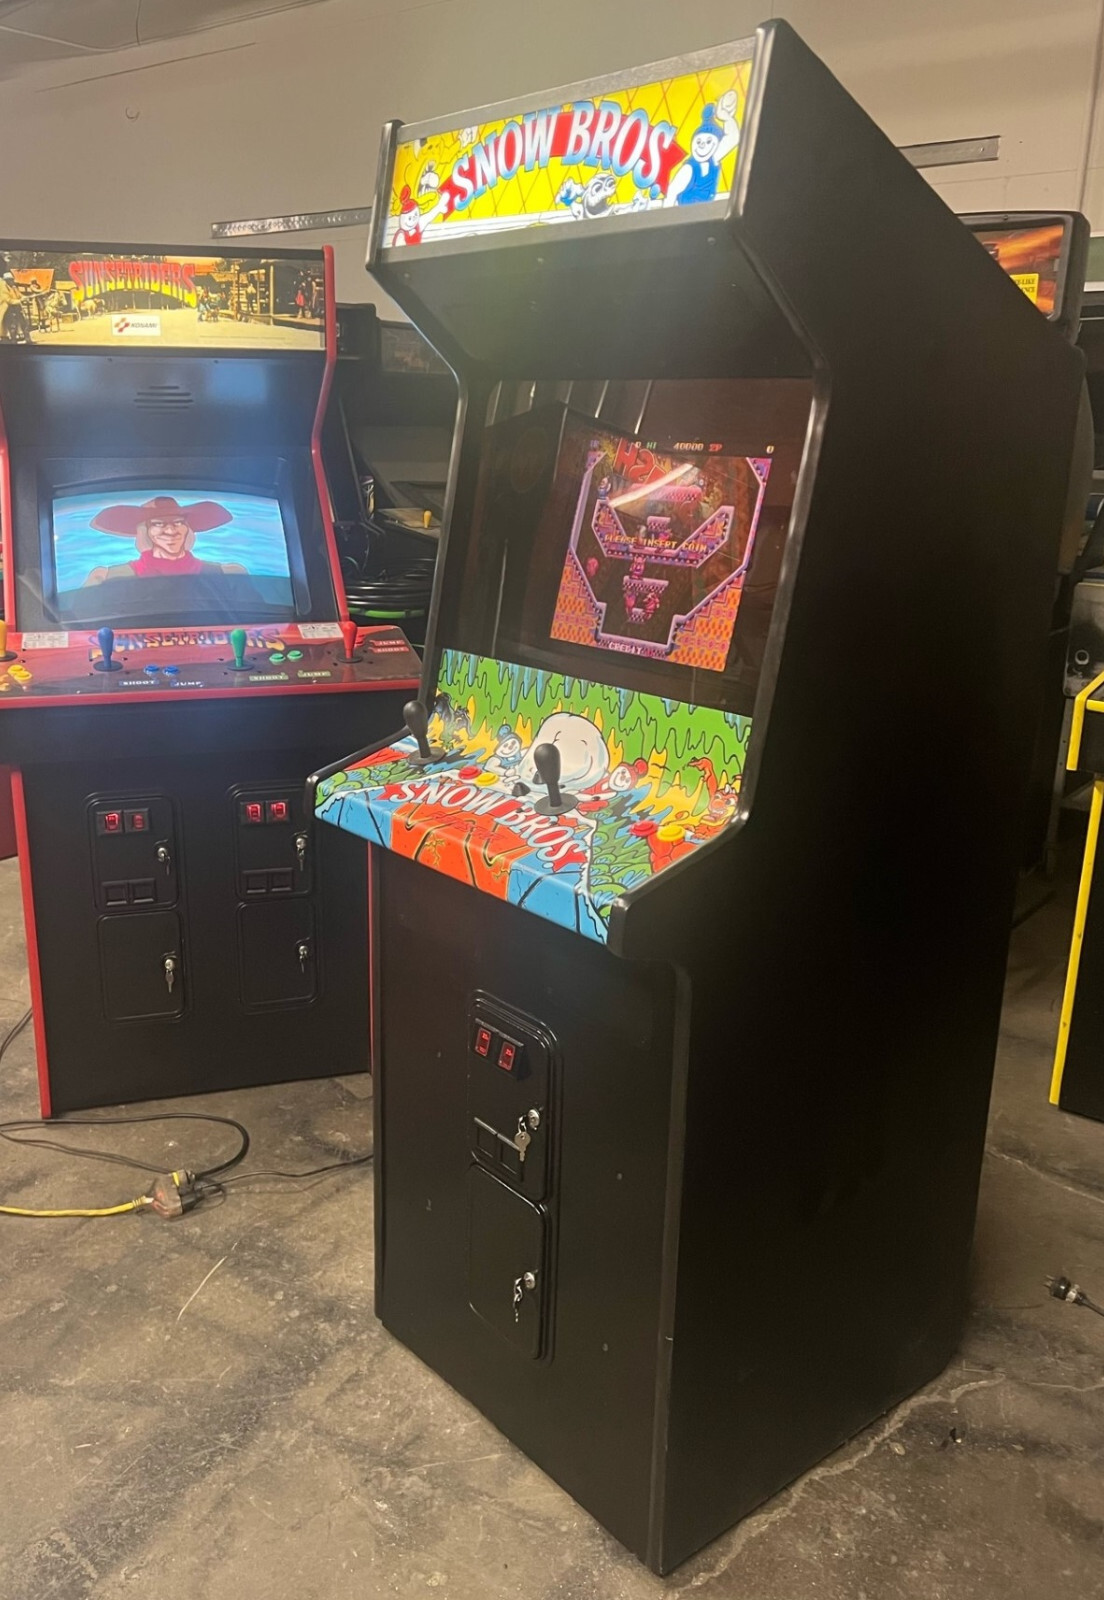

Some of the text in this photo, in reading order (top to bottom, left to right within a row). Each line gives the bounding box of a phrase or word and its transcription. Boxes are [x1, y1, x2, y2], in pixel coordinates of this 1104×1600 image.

[452, 106, 562, 211] SNOW
[646, 441, 658, 449] HI
[673, 442, 705, 451] 40000
[604, 533, 708, 553] PLEASE INSERT COIN
[608, 641, 642, 655] CREDIT
[389, 779, 515, 816] SNOW
